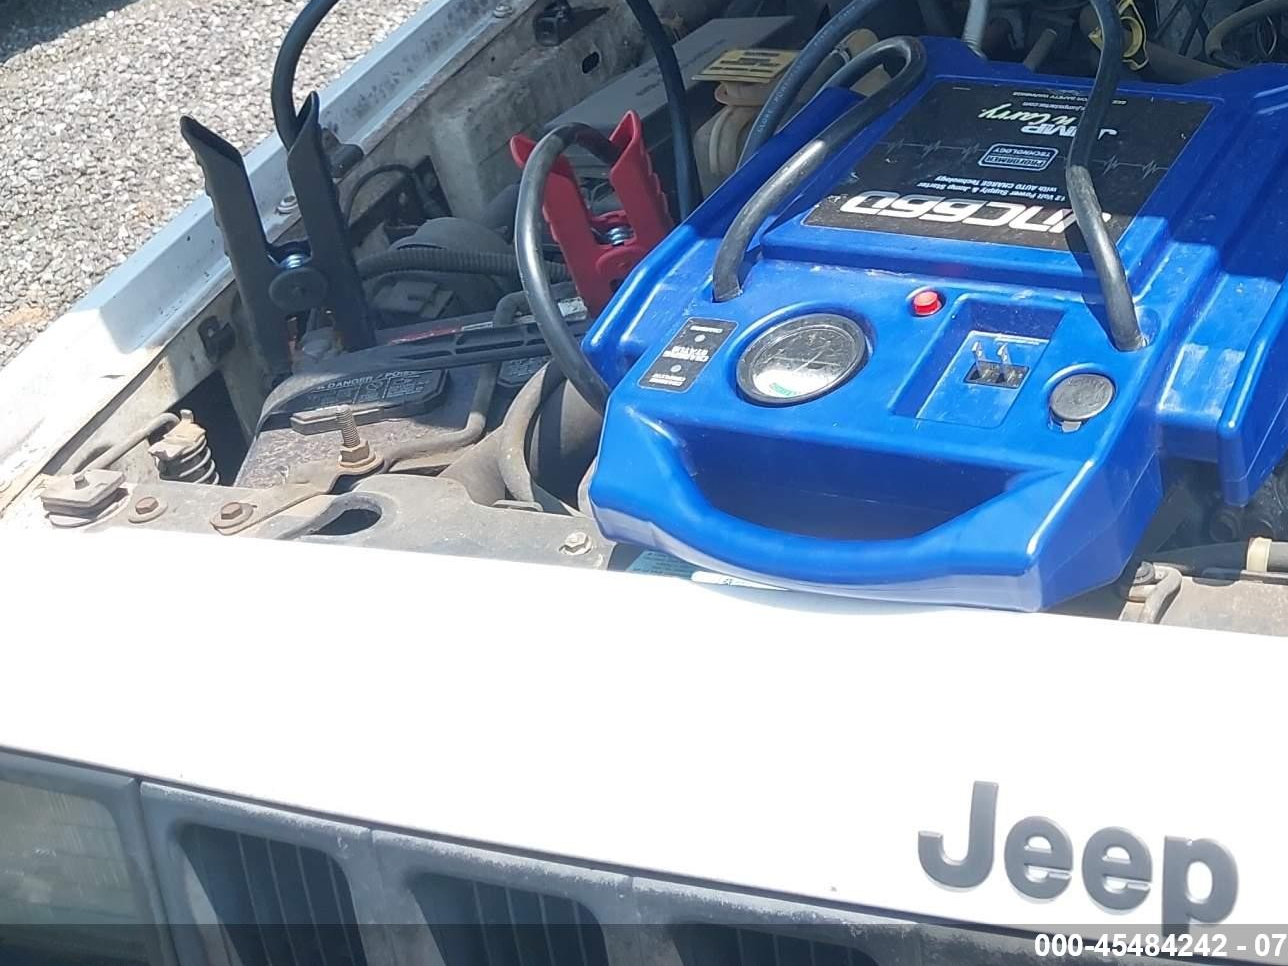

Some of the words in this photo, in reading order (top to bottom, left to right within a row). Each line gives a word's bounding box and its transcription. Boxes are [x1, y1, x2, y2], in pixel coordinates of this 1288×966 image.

[1021, 122, 1117, 141] JMP
[993, 147, 1051, 158] TECHNOLOGY
[916, 181, 947, 190] Starter
[934, 175, 985, 186] Technology
[984, 179, 1015, 189] CHARGE
[947, 184, 970, 193] Jump
[978, 186, 1008, 197] Supply
[1014, 182, 1039, 191] AUTO
[1008, 189, 1034, 199] Power
[1034, 192, 1053, 200] Volt
[917, 780, 1239, 937] Jeep
